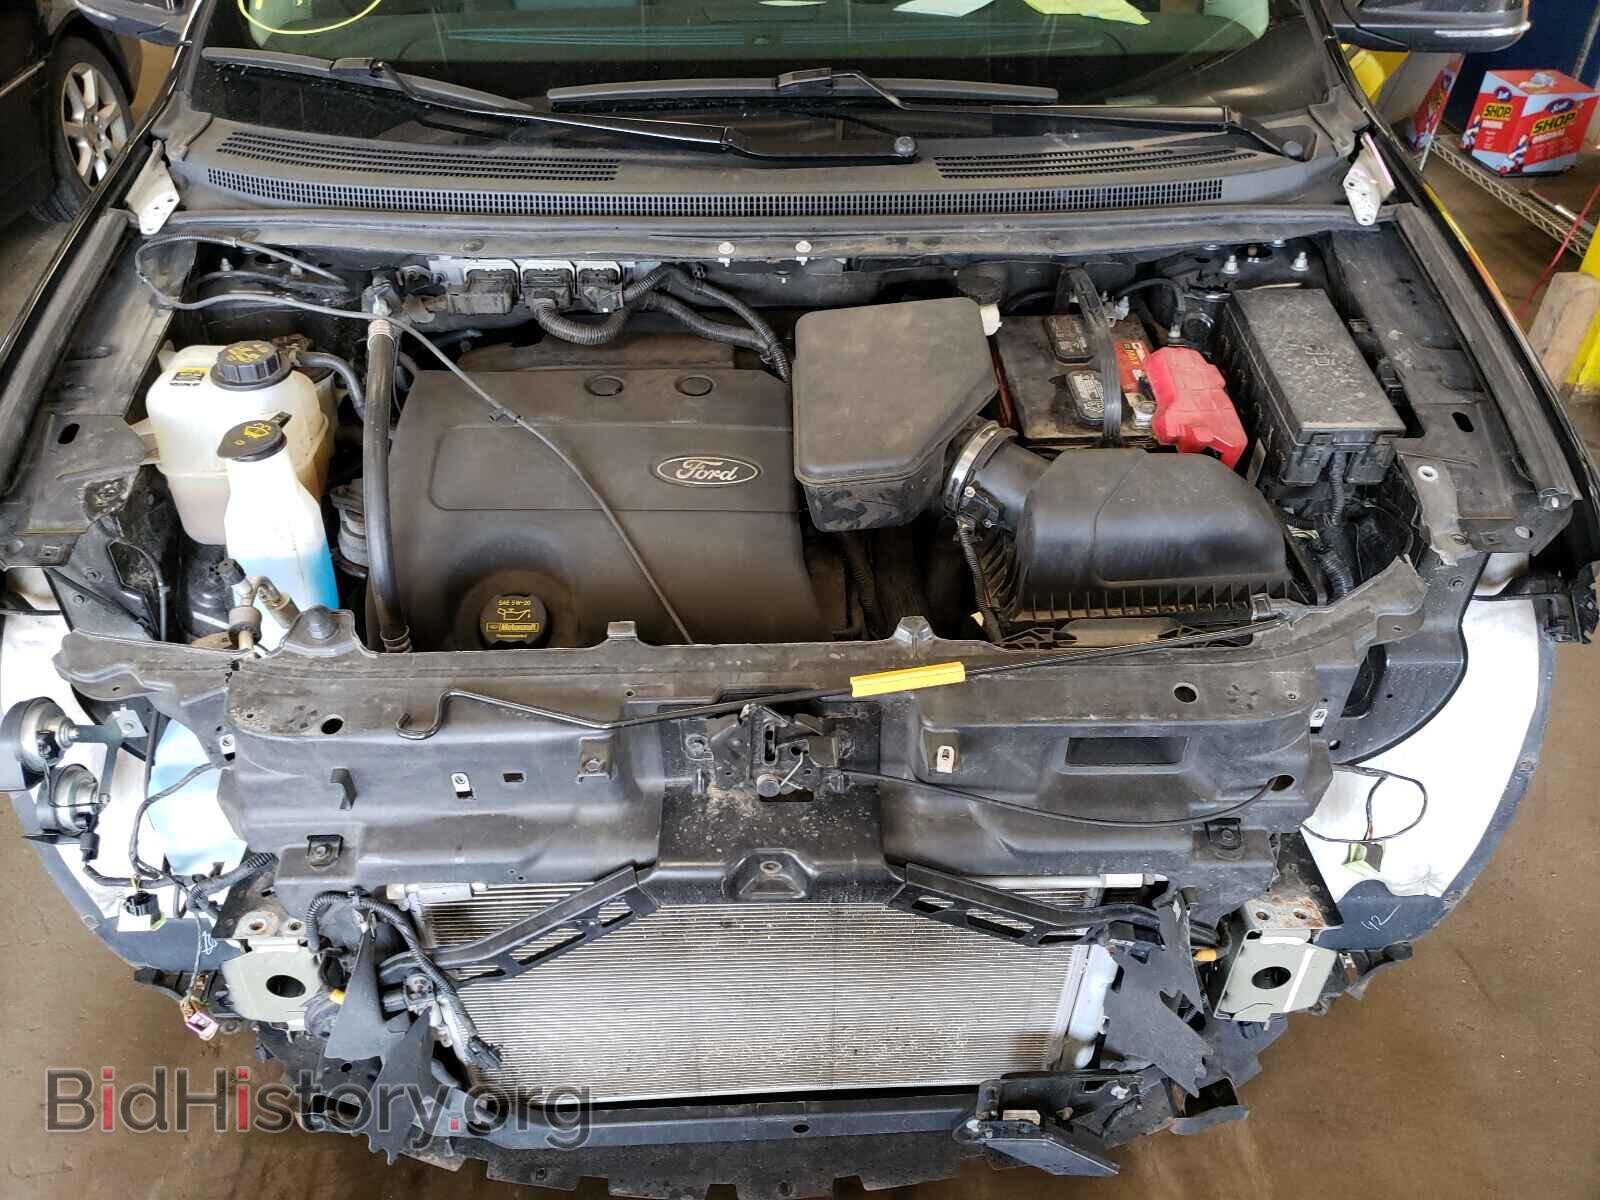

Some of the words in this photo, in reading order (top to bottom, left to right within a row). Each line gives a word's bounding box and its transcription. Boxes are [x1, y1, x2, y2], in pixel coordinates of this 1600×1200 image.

[1484, 105, 1512, 118] SHOP
[1533, 112, 1577, 134] SHOP
[675, 459, 739, 481] Ford
